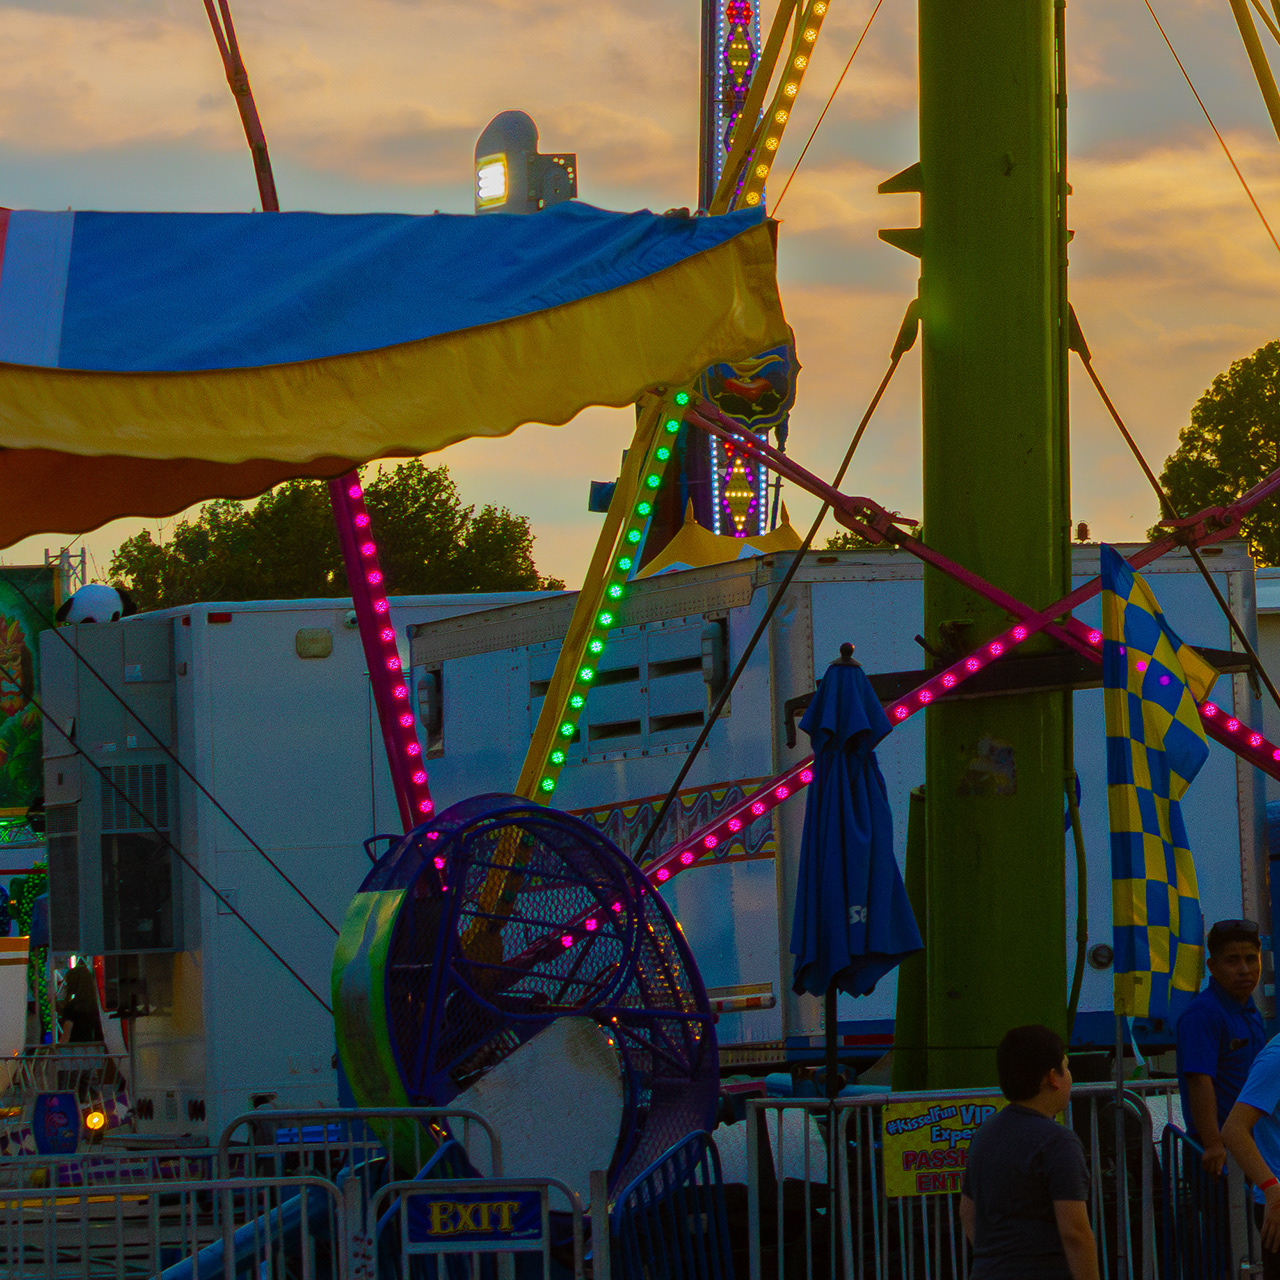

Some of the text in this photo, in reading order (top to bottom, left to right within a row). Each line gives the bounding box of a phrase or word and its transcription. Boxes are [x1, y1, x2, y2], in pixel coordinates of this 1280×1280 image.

[886, 1103, 996, 1135] #KisselFun VIP
[931, 1125, 976, 1148] Expe
[426, 1200, 523, 1236] EXIT
